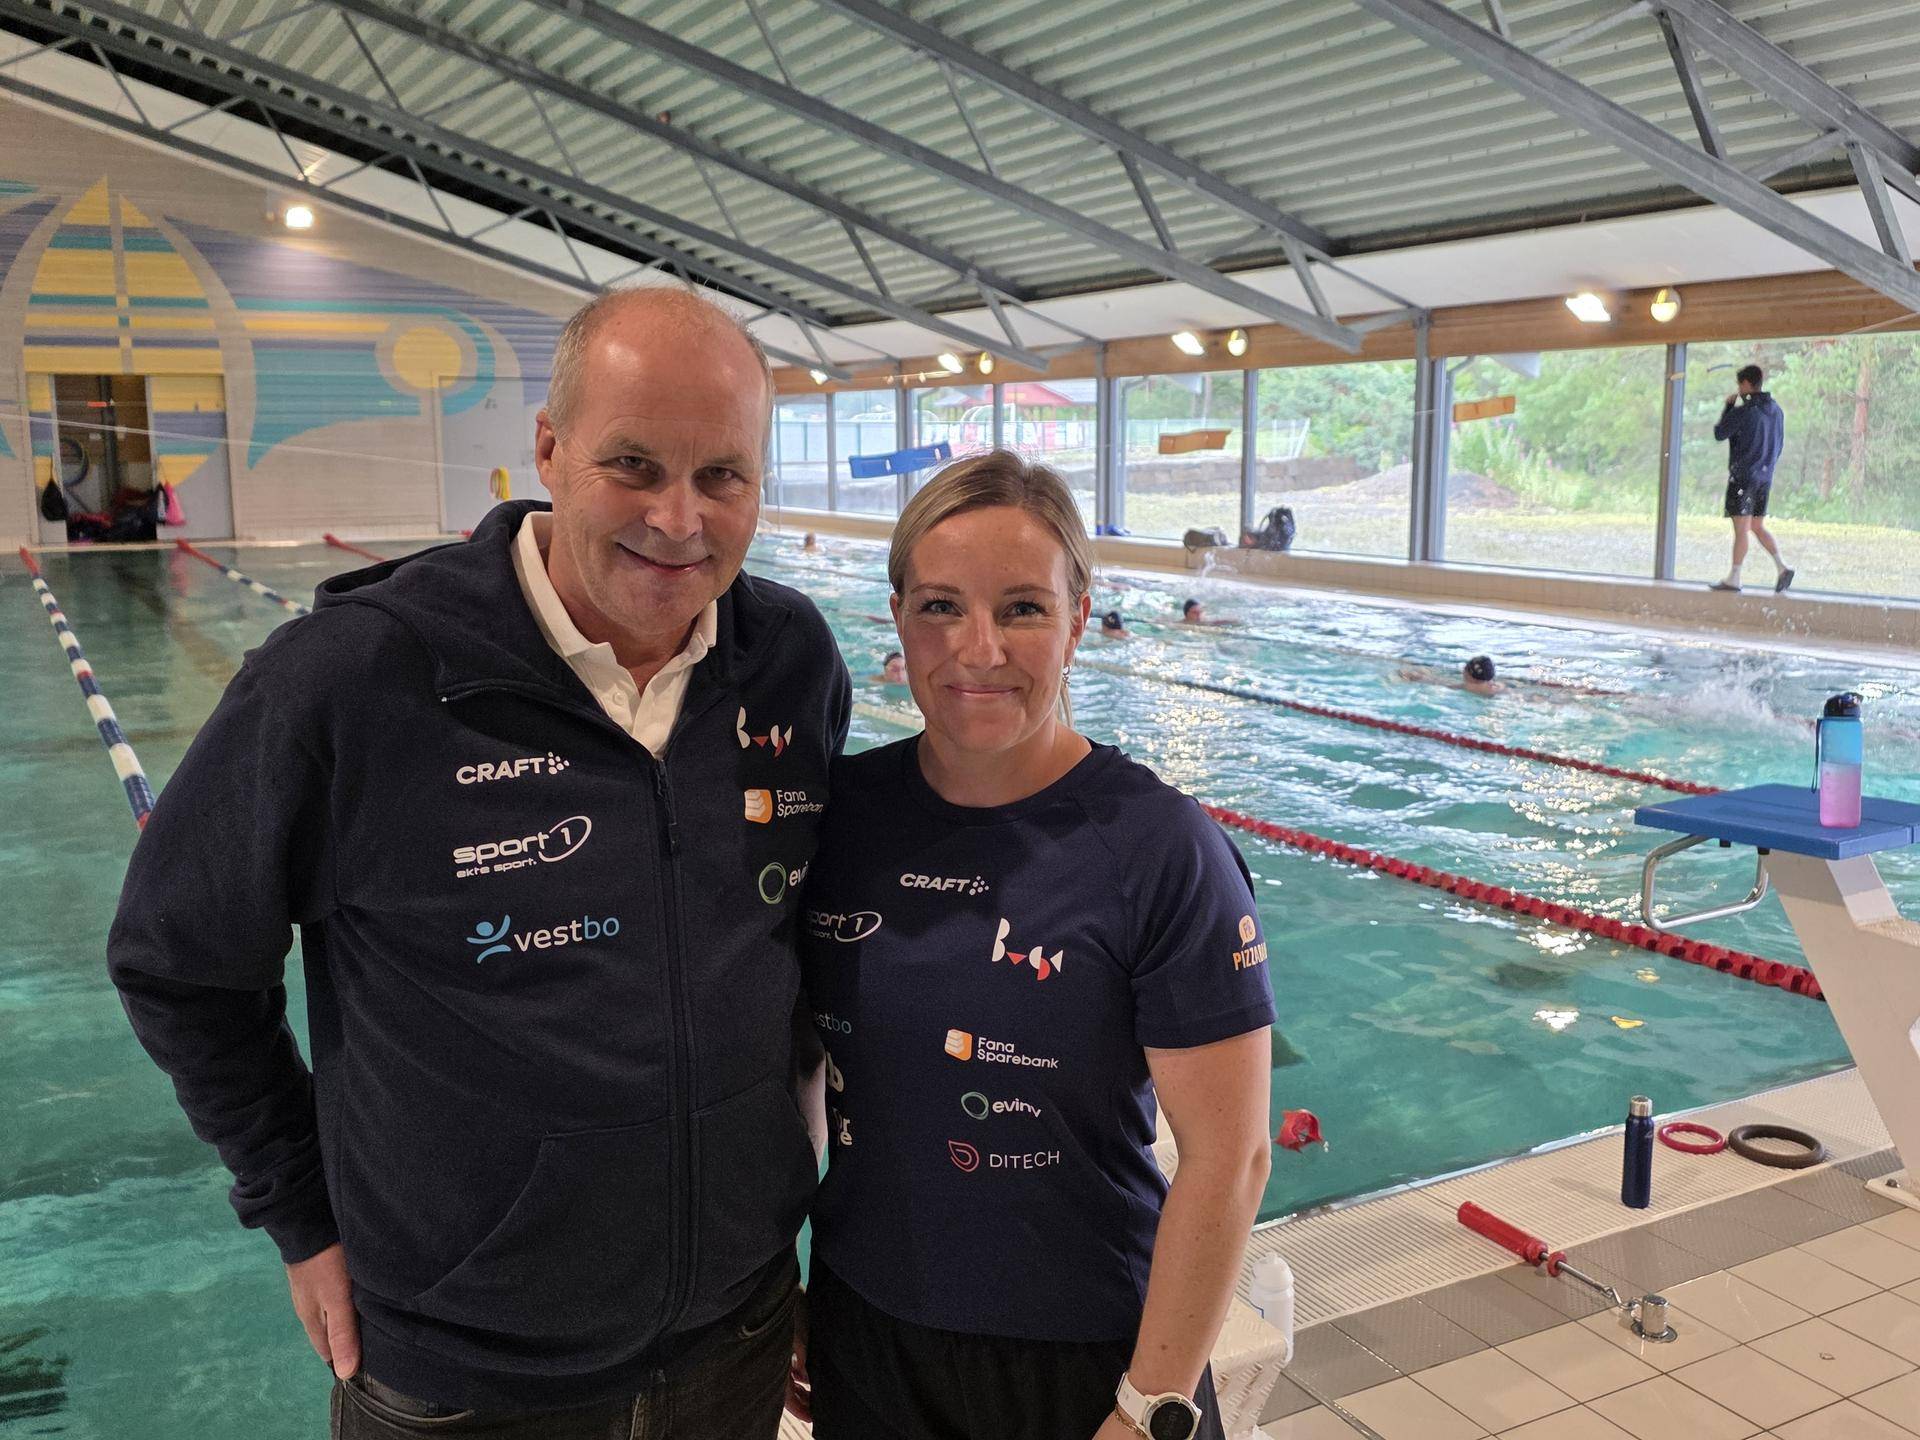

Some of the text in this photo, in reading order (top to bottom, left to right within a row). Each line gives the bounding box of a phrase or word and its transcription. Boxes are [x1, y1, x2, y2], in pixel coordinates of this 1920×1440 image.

[456, 757, 545, 785] CRAFT
[776, 789, 807, 803] Fana
[777, 801, 825, 819] Spareban
[453, 832, 550, 865] sport
[456, 864, 491, 879] ekte
[899, 873, 970, 893] CRAFT
[808, 911, 847, 929] port
[513, 915, 620, 952] vestbo
[815, 1011, 852, 1035] stbo
[978, 1037, 1015, 1053] Fana
[976, 1048, 1059, 1069] Sparebank
[989, 1150, 1060, 1170] DITECH
